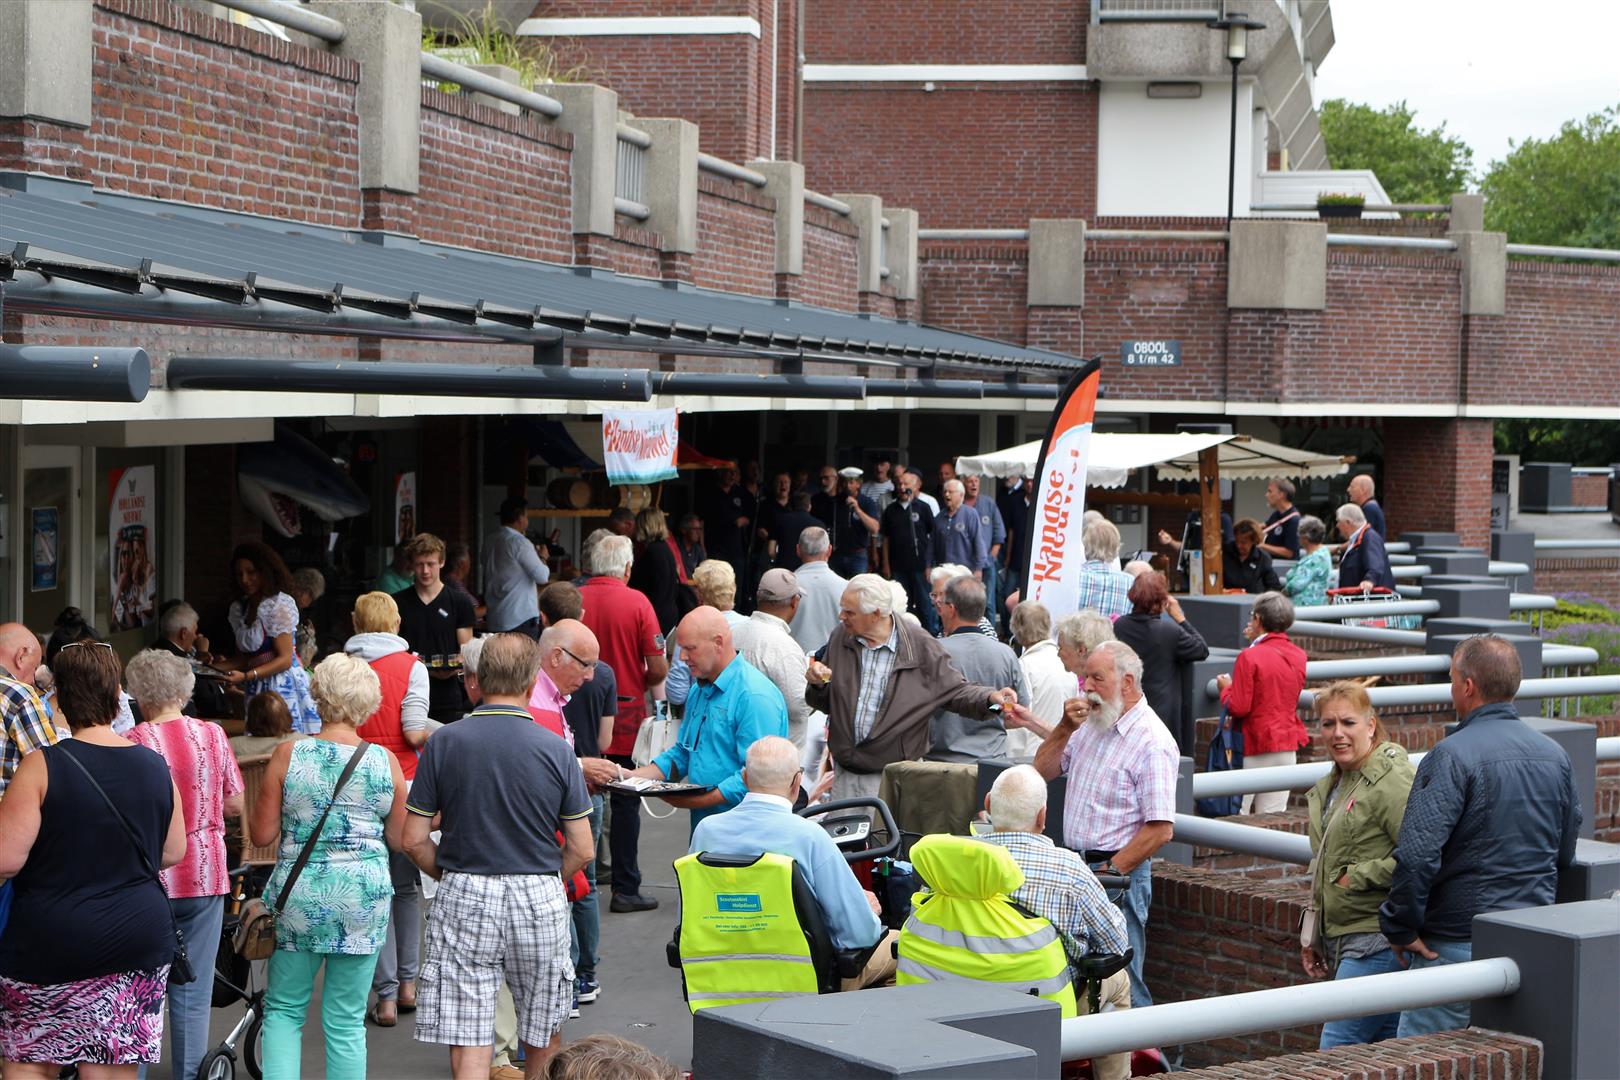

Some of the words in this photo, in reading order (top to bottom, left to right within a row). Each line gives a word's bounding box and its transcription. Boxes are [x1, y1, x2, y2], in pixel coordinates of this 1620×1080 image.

[1133, 341, 1169, 354] OBOOL
[1127, 353, 1135, 365] 8
[1138, 354, 1157, 364] t/m
[1160, 353, 1175, 364] 42
